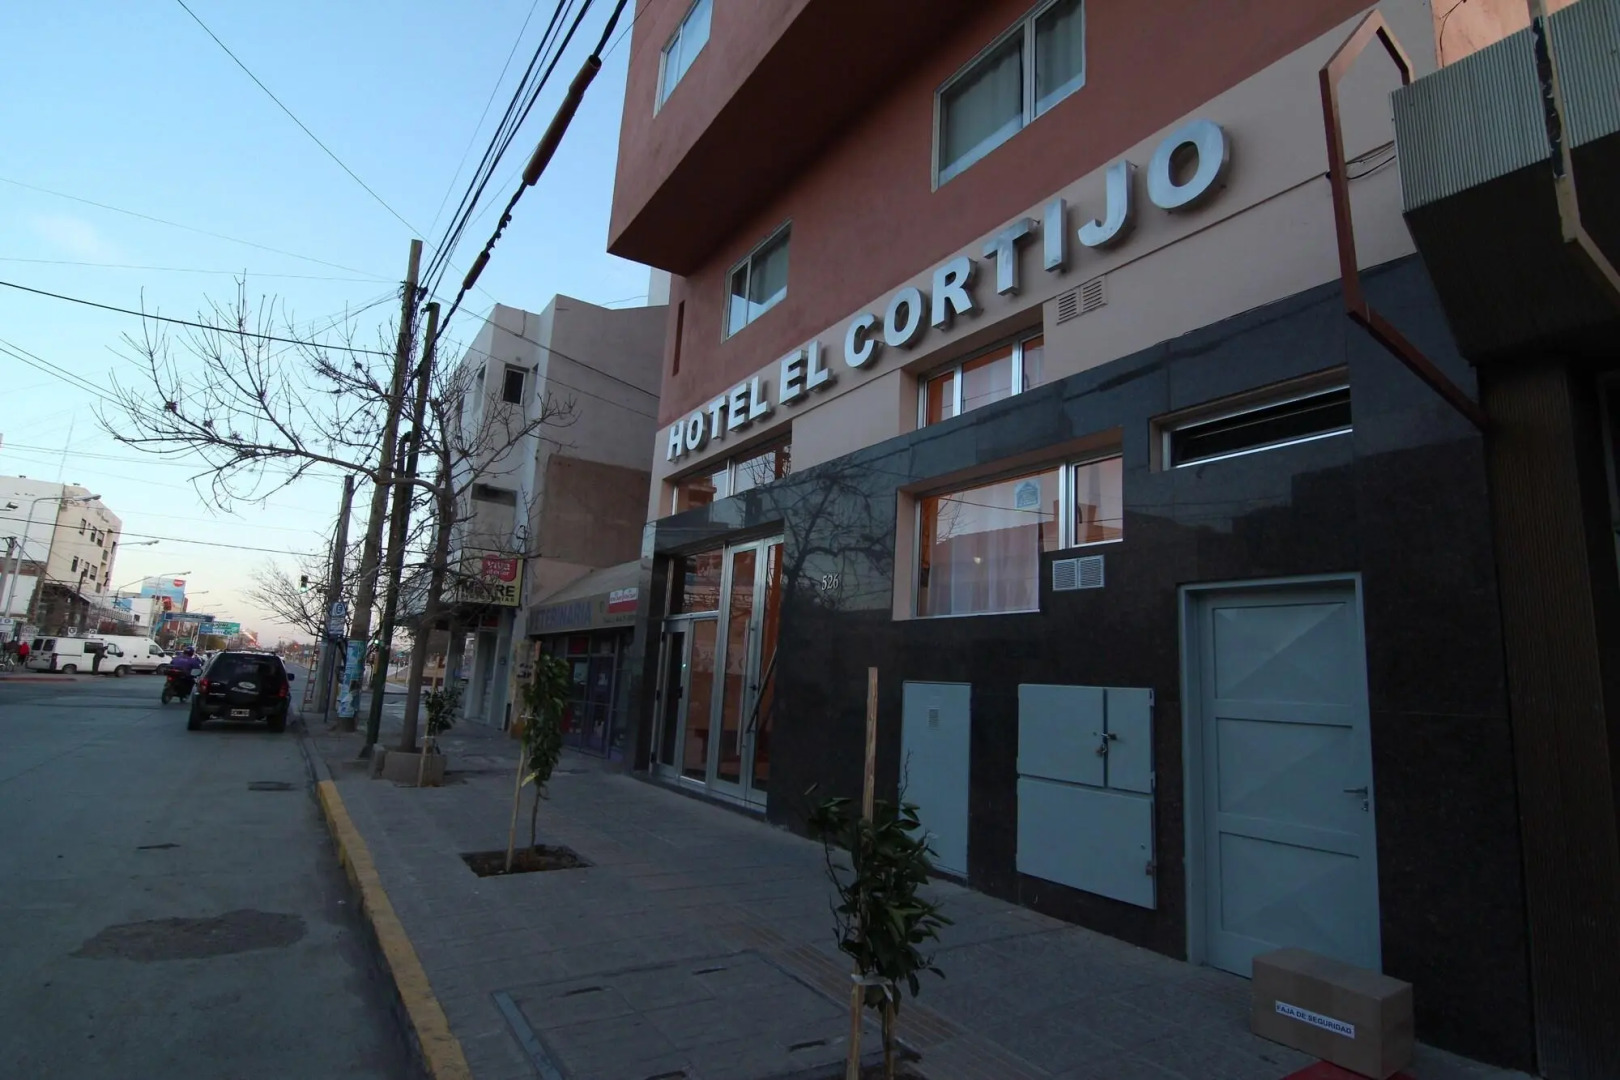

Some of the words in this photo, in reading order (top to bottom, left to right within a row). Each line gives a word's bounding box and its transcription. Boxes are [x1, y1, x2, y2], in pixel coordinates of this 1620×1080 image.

[666, 375, 771, 463] HOTEL
[779, 340, 834, 406] EL
[844, 118, 1230, 370] CORTIJO
[821, 573, 839, 591] 526
[1276, 1005, 1295, 1016] FAJA
[1296, 1010, 1307, 1020] DE
[1308, 1015, 1352, 1034] SEGURIDAD
